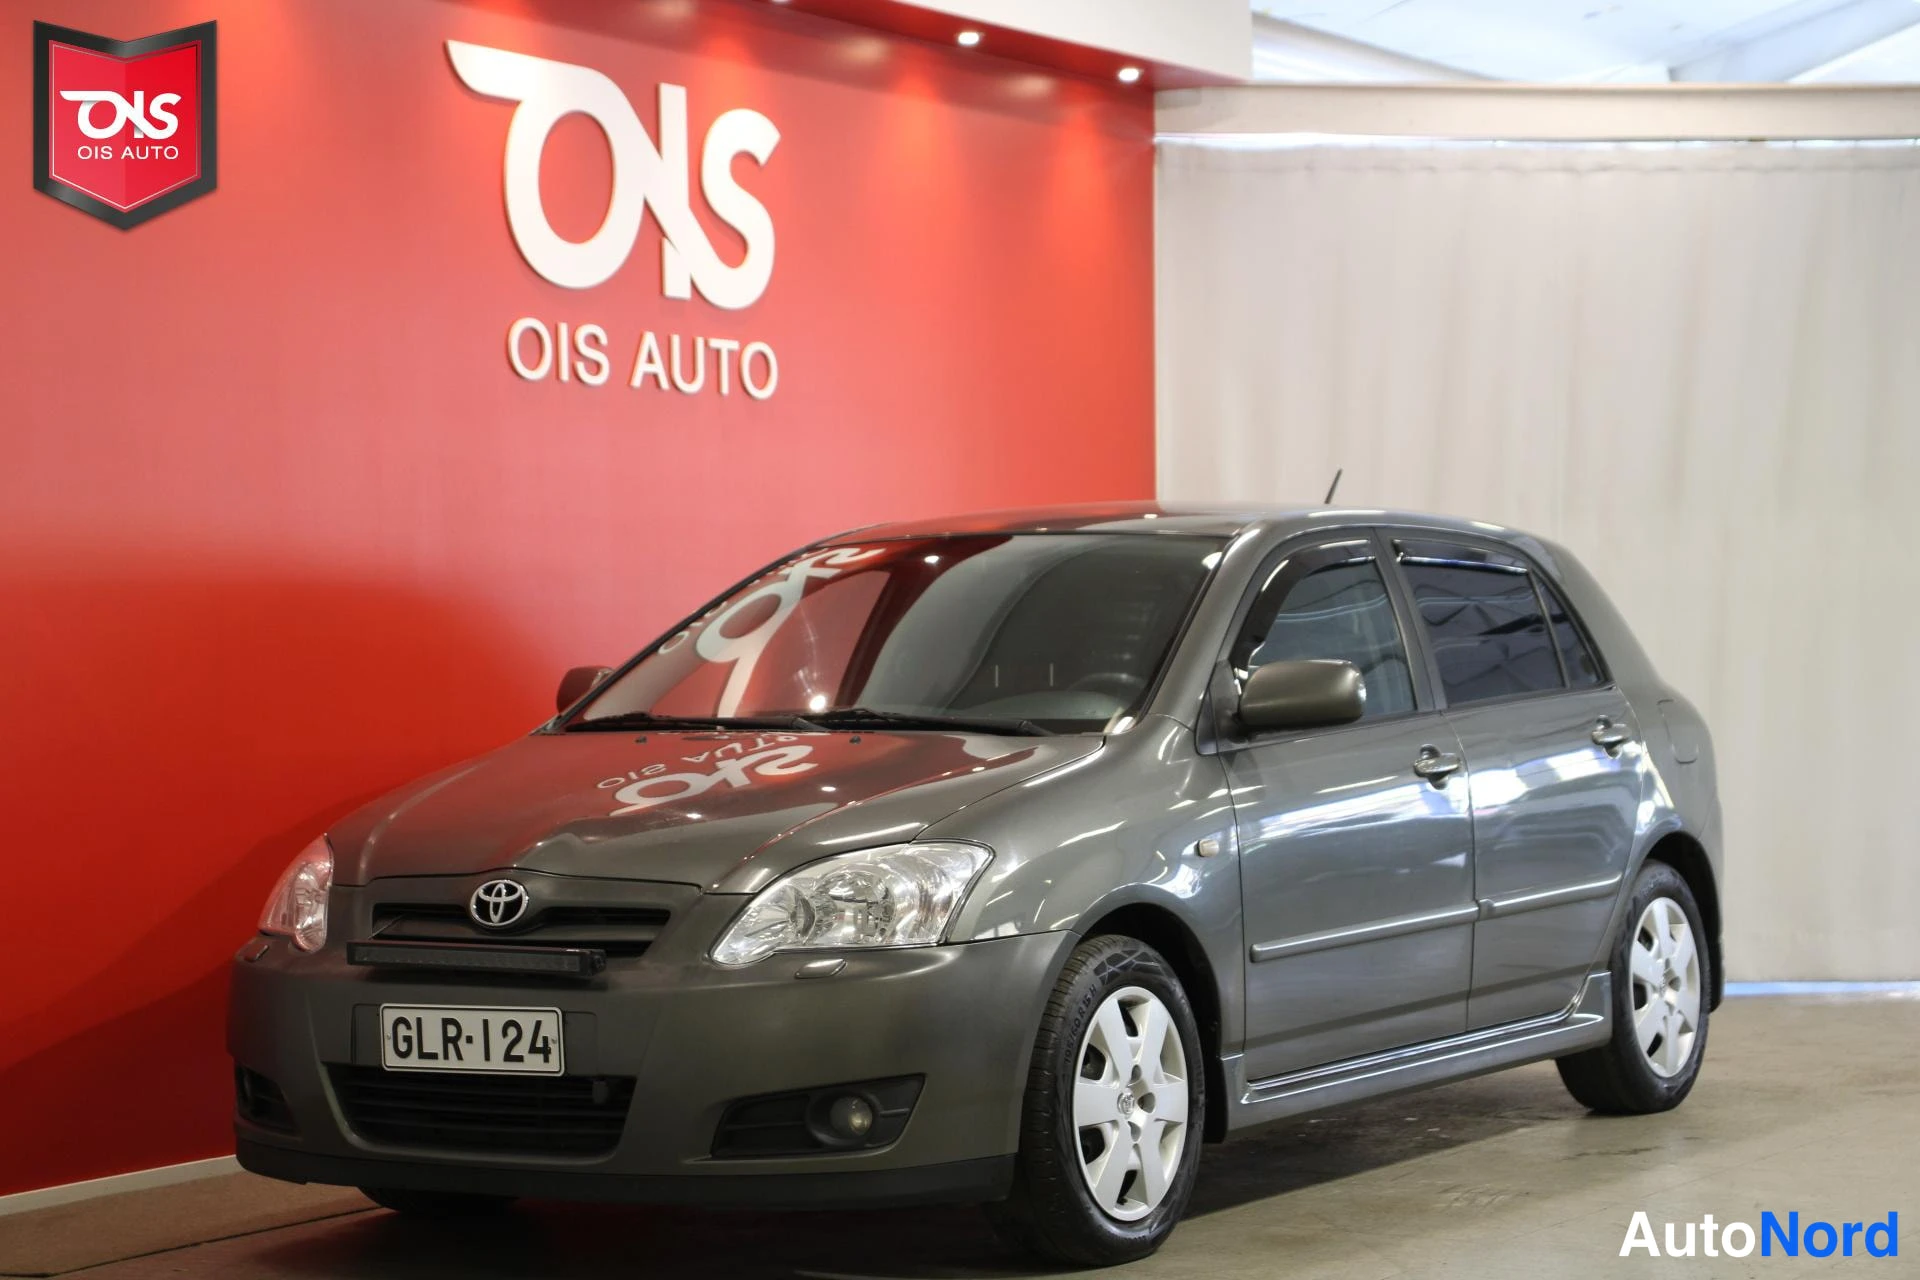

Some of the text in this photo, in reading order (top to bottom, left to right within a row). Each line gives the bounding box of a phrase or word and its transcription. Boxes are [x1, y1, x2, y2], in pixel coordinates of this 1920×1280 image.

[507, 317, 778, 400] OIS AUTO
[391, 1015, 552, 1063] GLR-124
